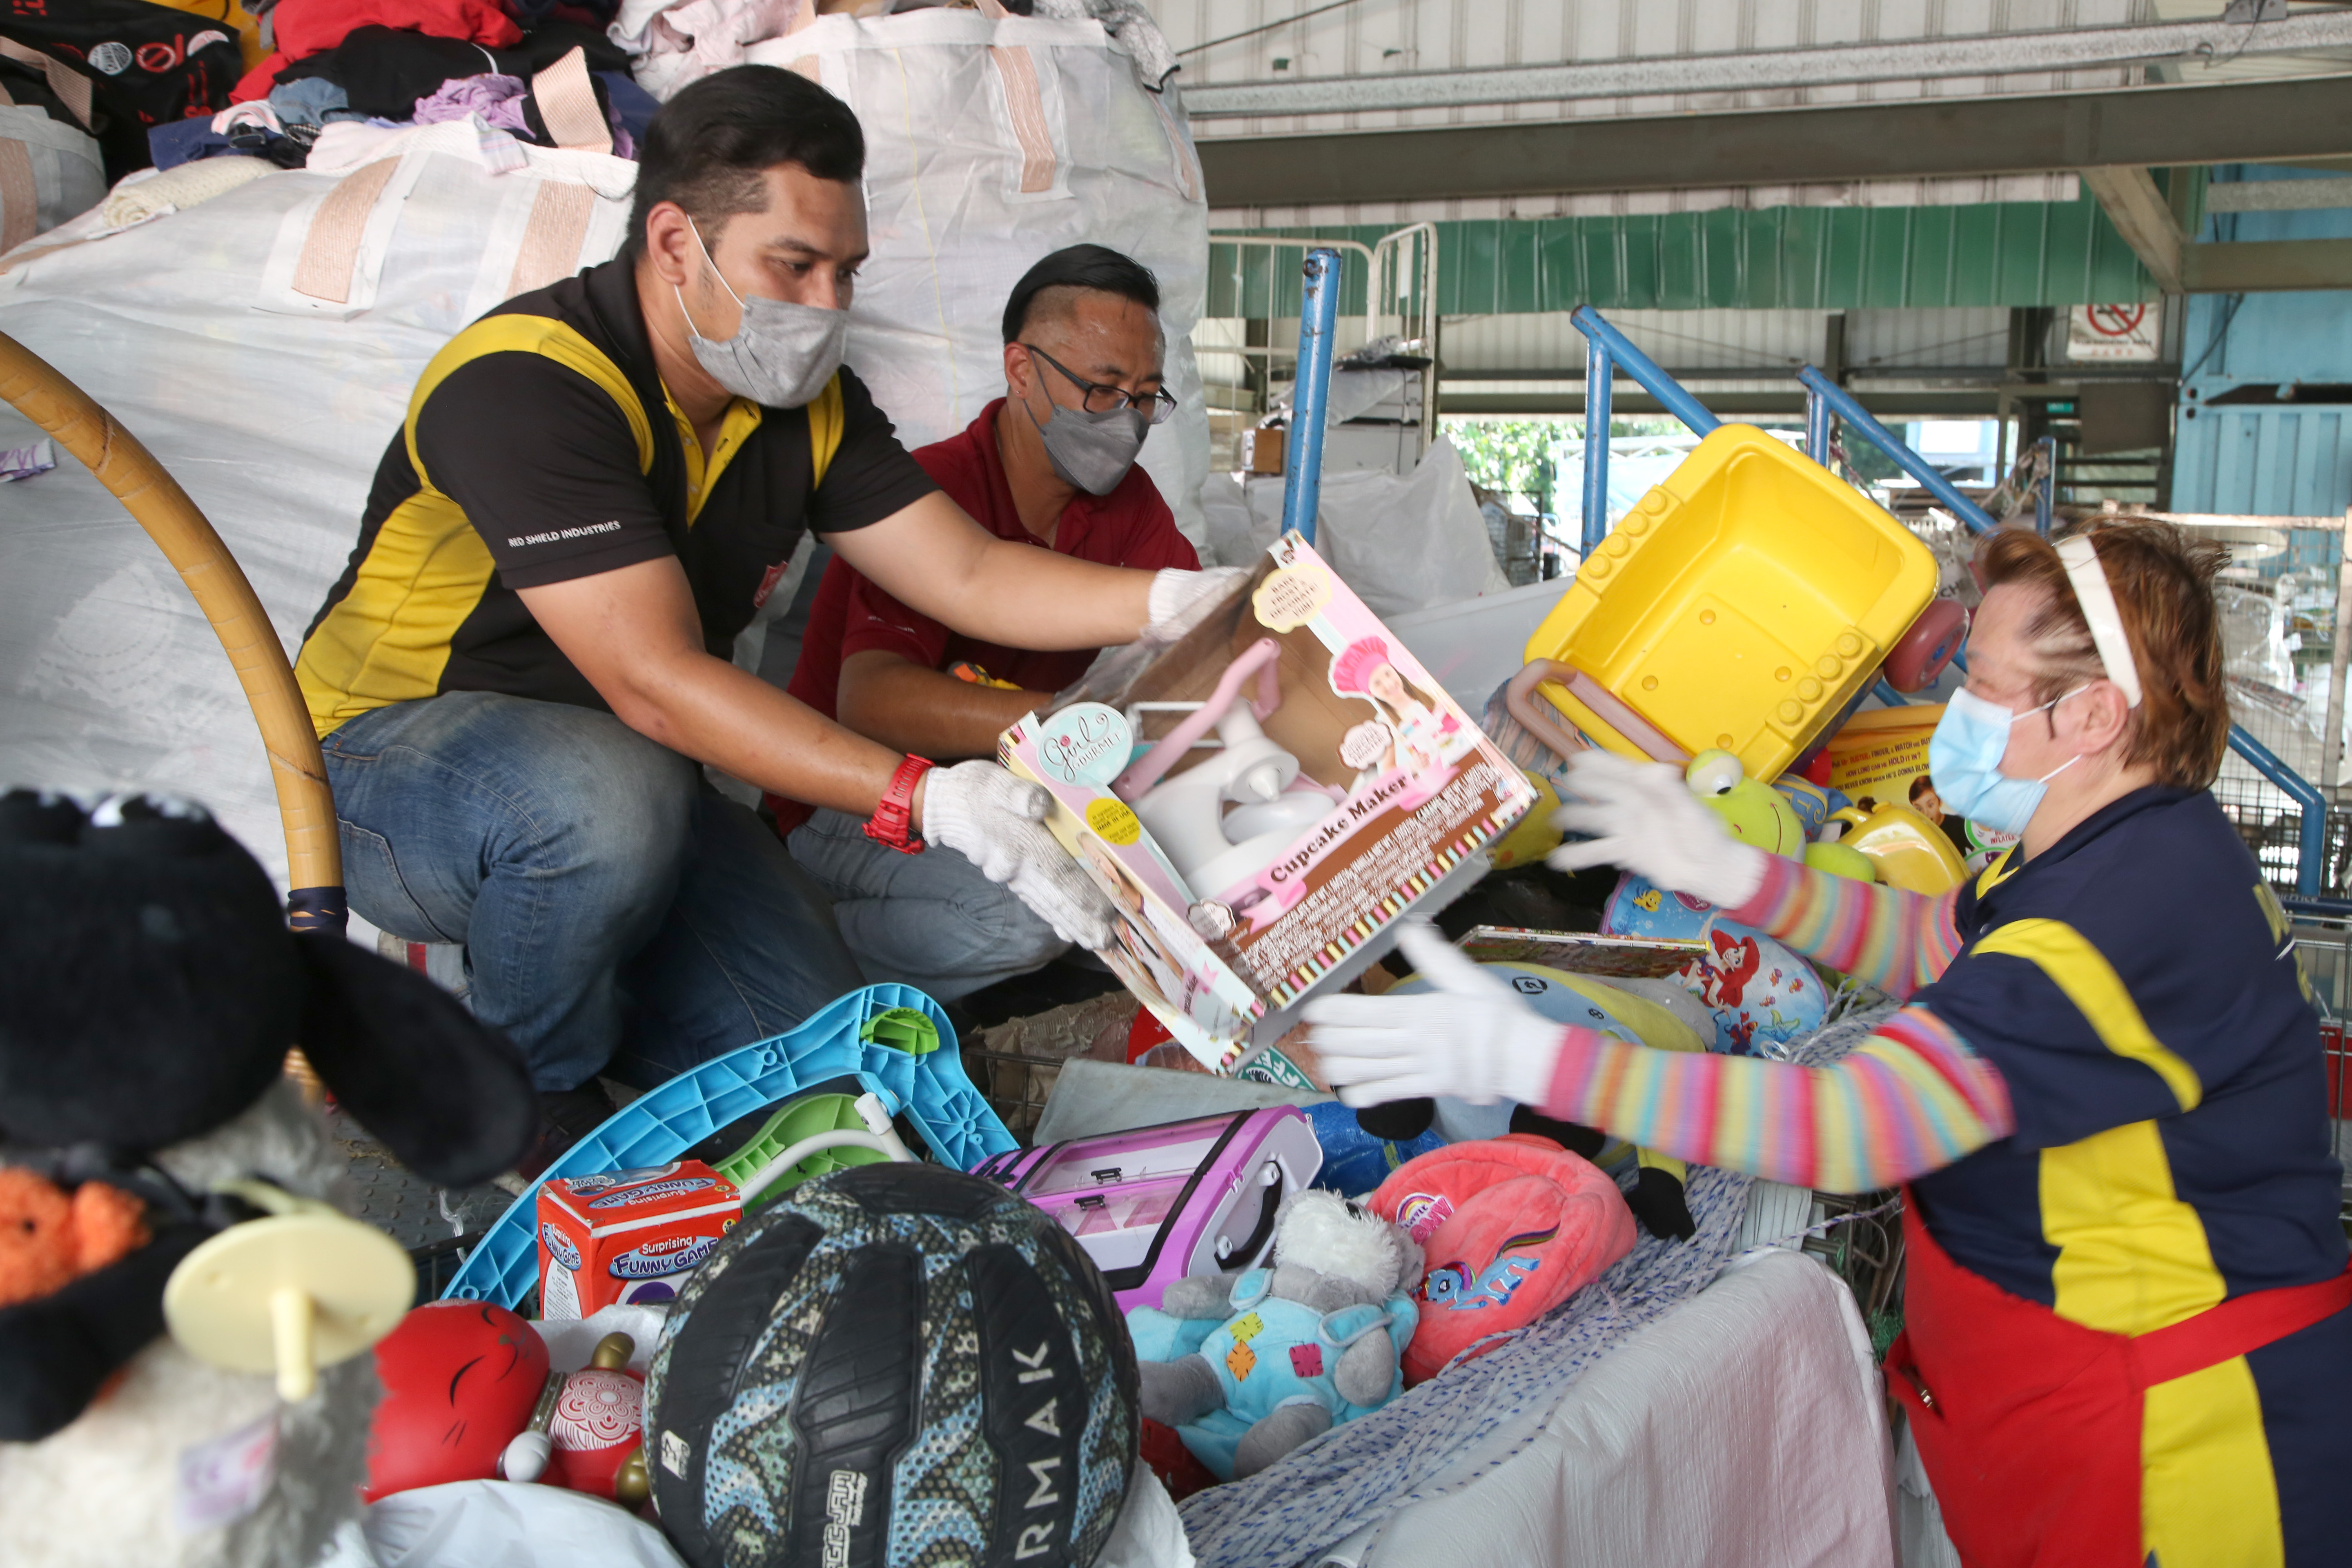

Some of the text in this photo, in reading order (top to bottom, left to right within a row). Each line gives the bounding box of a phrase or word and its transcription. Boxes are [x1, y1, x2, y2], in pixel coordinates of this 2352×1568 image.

[508, 520, 621, 548] RED SHIELD INDUSTRIES
[1042, 713, 1110, 783] Girl
[1073, 733, 1121, 771] GOURMET
[1895, 741, 1913, 752] WATCH
[1921, 737, 1931, 746] BUT
[1889, 755, 1904, 766] HOLD
[1844, 782, 1859, 790] NEVER
[1898, 766, 1915, 776] GONNA
[1270, 817, 1349, 882] Cupcake
[1348, 775, 1407, 821] Maker
[593, 1178, 713, 1209] FUNNY GAME
[628, 1189, 686, 1205] Surprising
[552, 1223, 571, 1248] Surprising
[1410, 1198, 1454, 1245] ONY
[543, 1222, 579, 1265] FUNNY GAME
[642, 1236, 693, 1255] Surprising
[612, 1252, 673, 1276] FUNNY
[1011, 1340, 1061, 1561] RMAK
[830, 1473, 851, 1524] JAM
